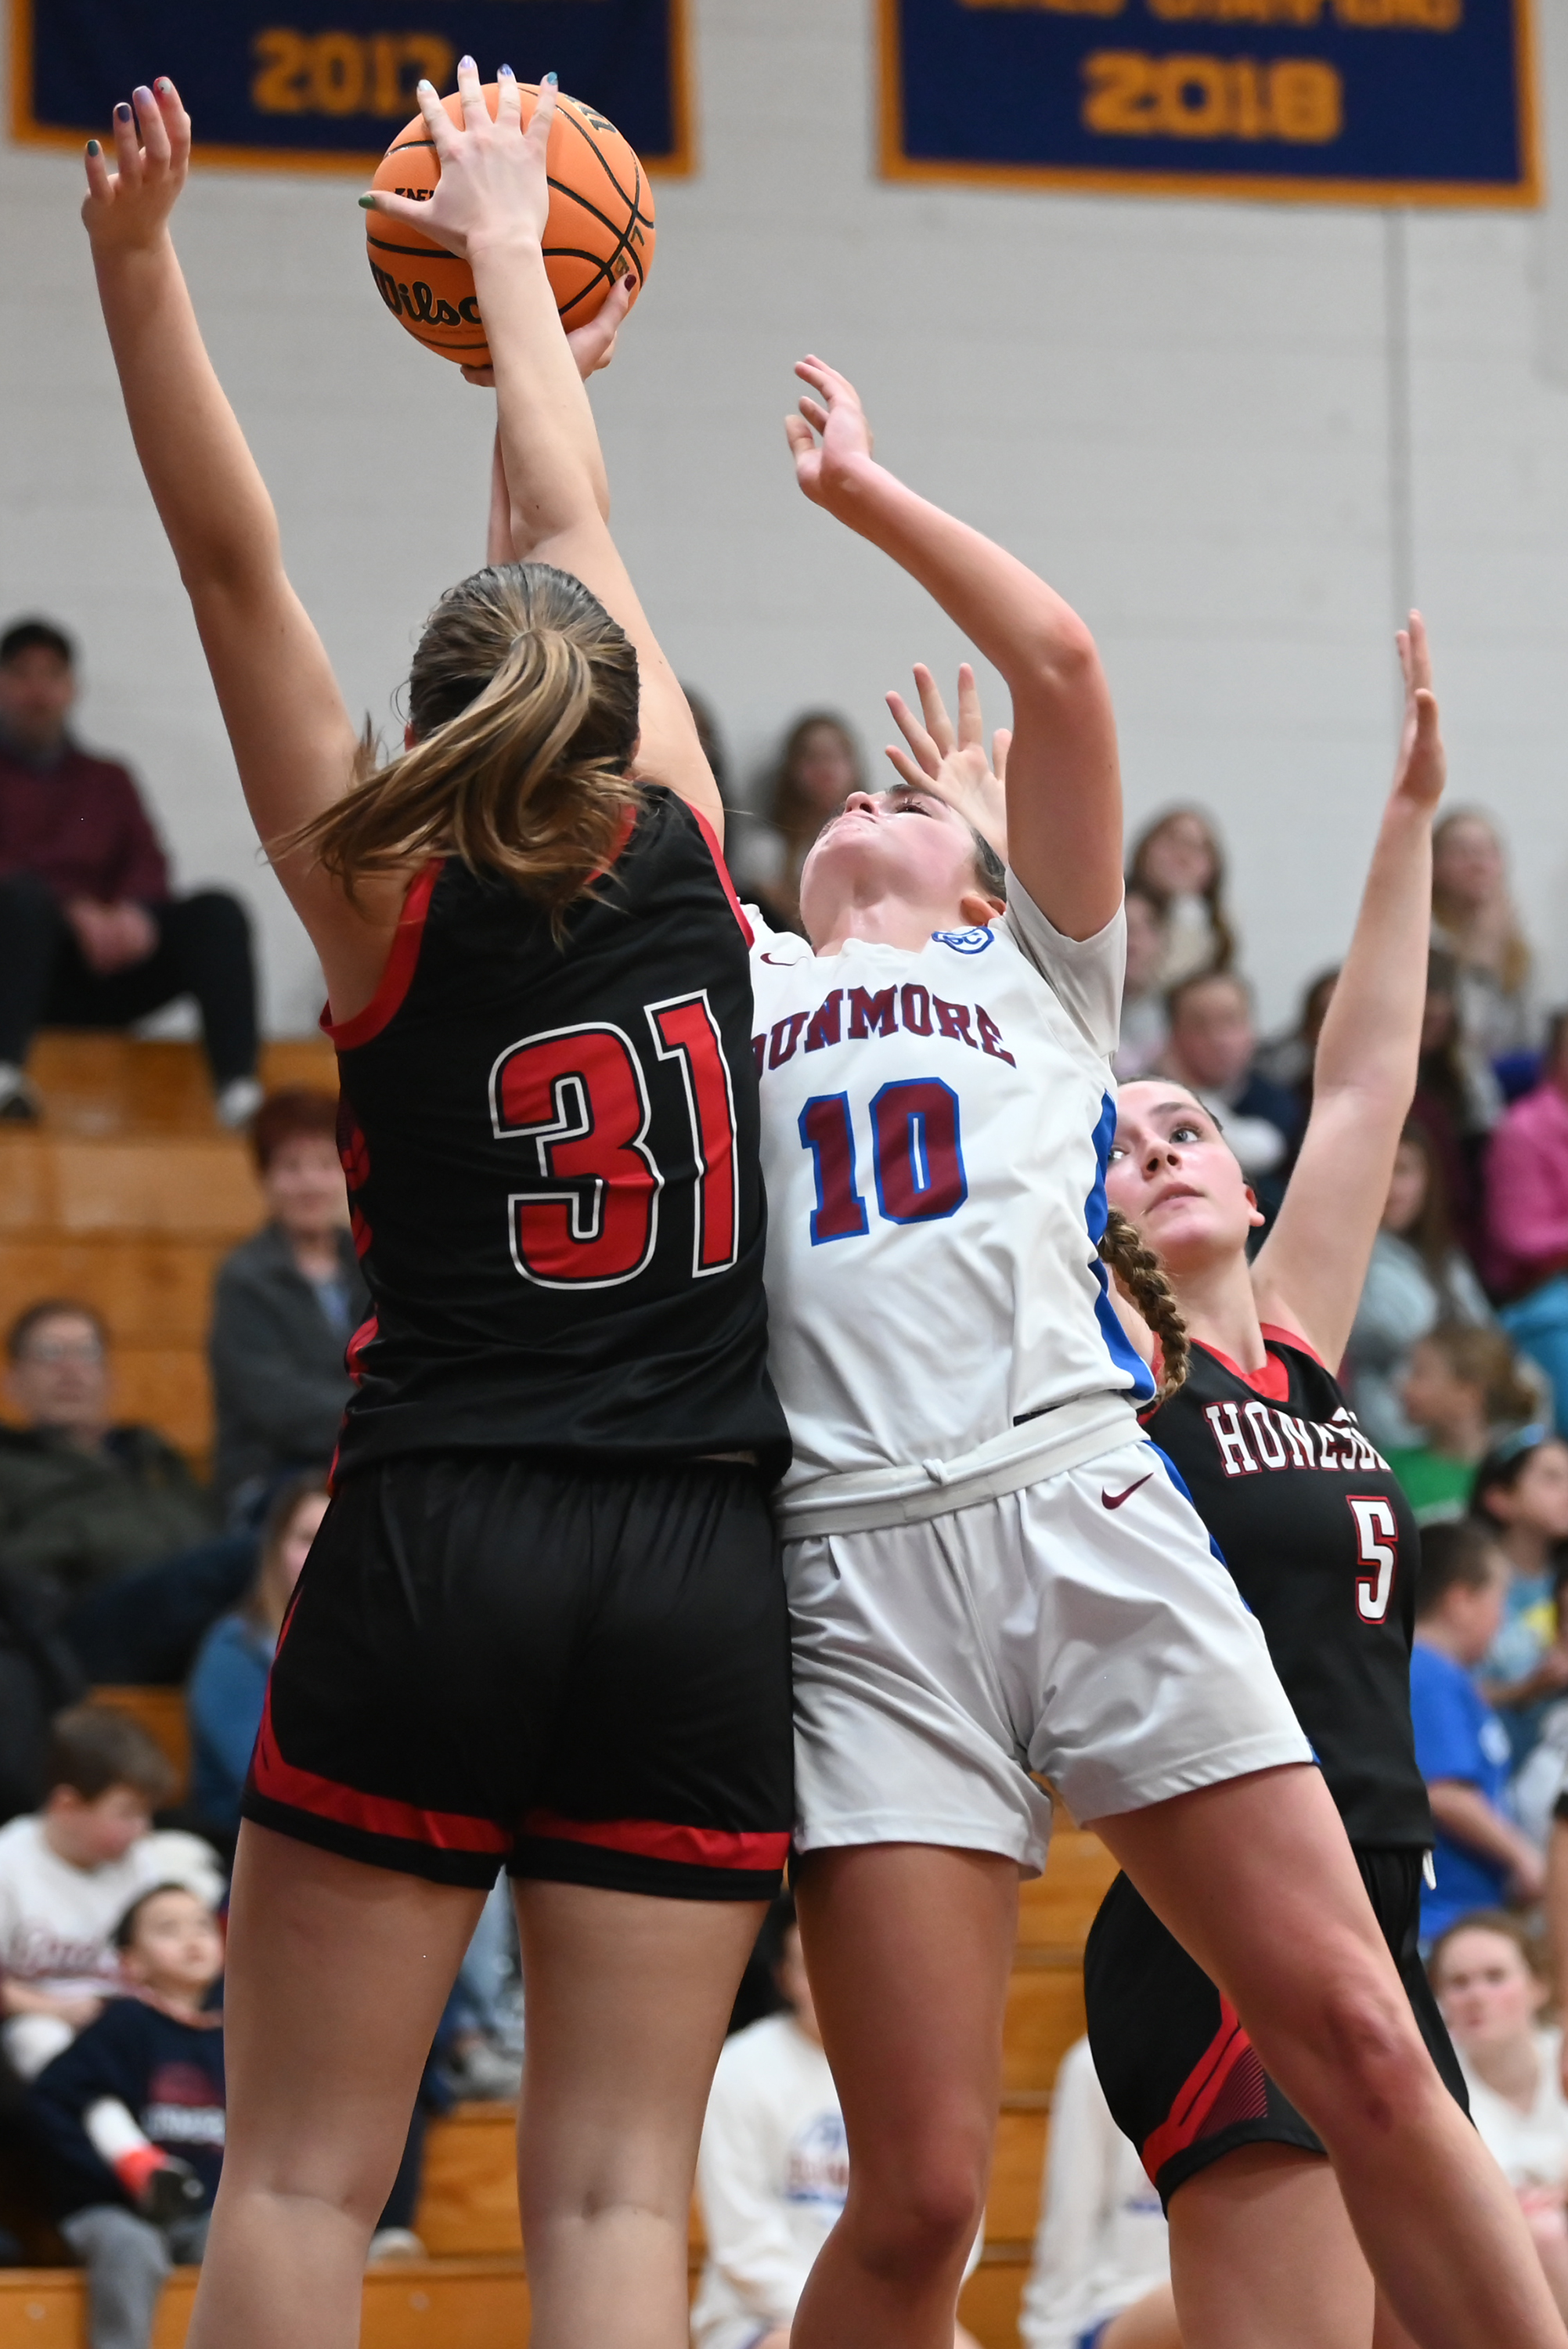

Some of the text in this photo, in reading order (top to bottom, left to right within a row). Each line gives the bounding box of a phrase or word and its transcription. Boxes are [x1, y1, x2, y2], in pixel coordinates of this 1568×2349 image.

[253, 27, 453, 114] 2017
[1082, 50, 1341, 143] 2018
[369, 258, 483, 327] Wilso
[488, 989, 738, 1290] 31
[798, 1077, 968, 1247] 10
[1346, 1496, 1398, 1625] 5
